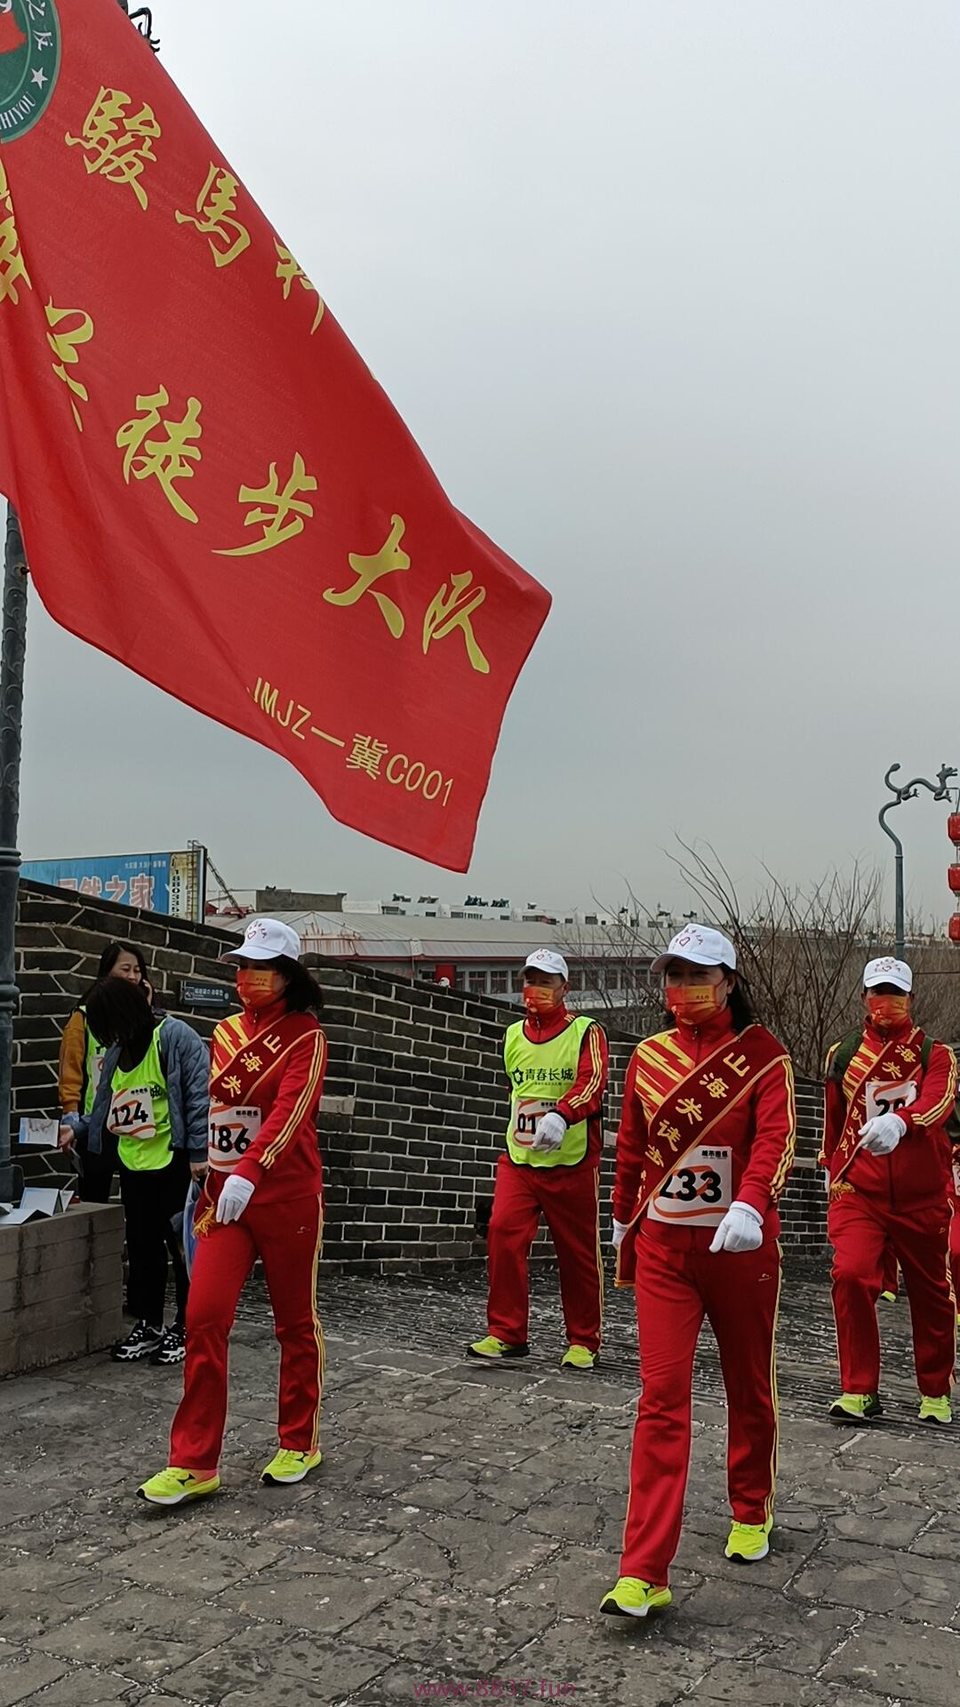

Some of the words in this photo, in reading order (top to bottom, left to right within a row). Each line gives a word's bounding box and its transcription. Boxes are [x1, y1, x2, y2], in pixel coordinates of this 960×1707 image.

[0, 92, 37, 130] HIYOU
[211, 1034, 282, 1105] 山海关
[525, 1067, 574, 1081] 青春长城
[112, 1102, 149, 1127] 124
[210, 1122, 252, 1154] 186
